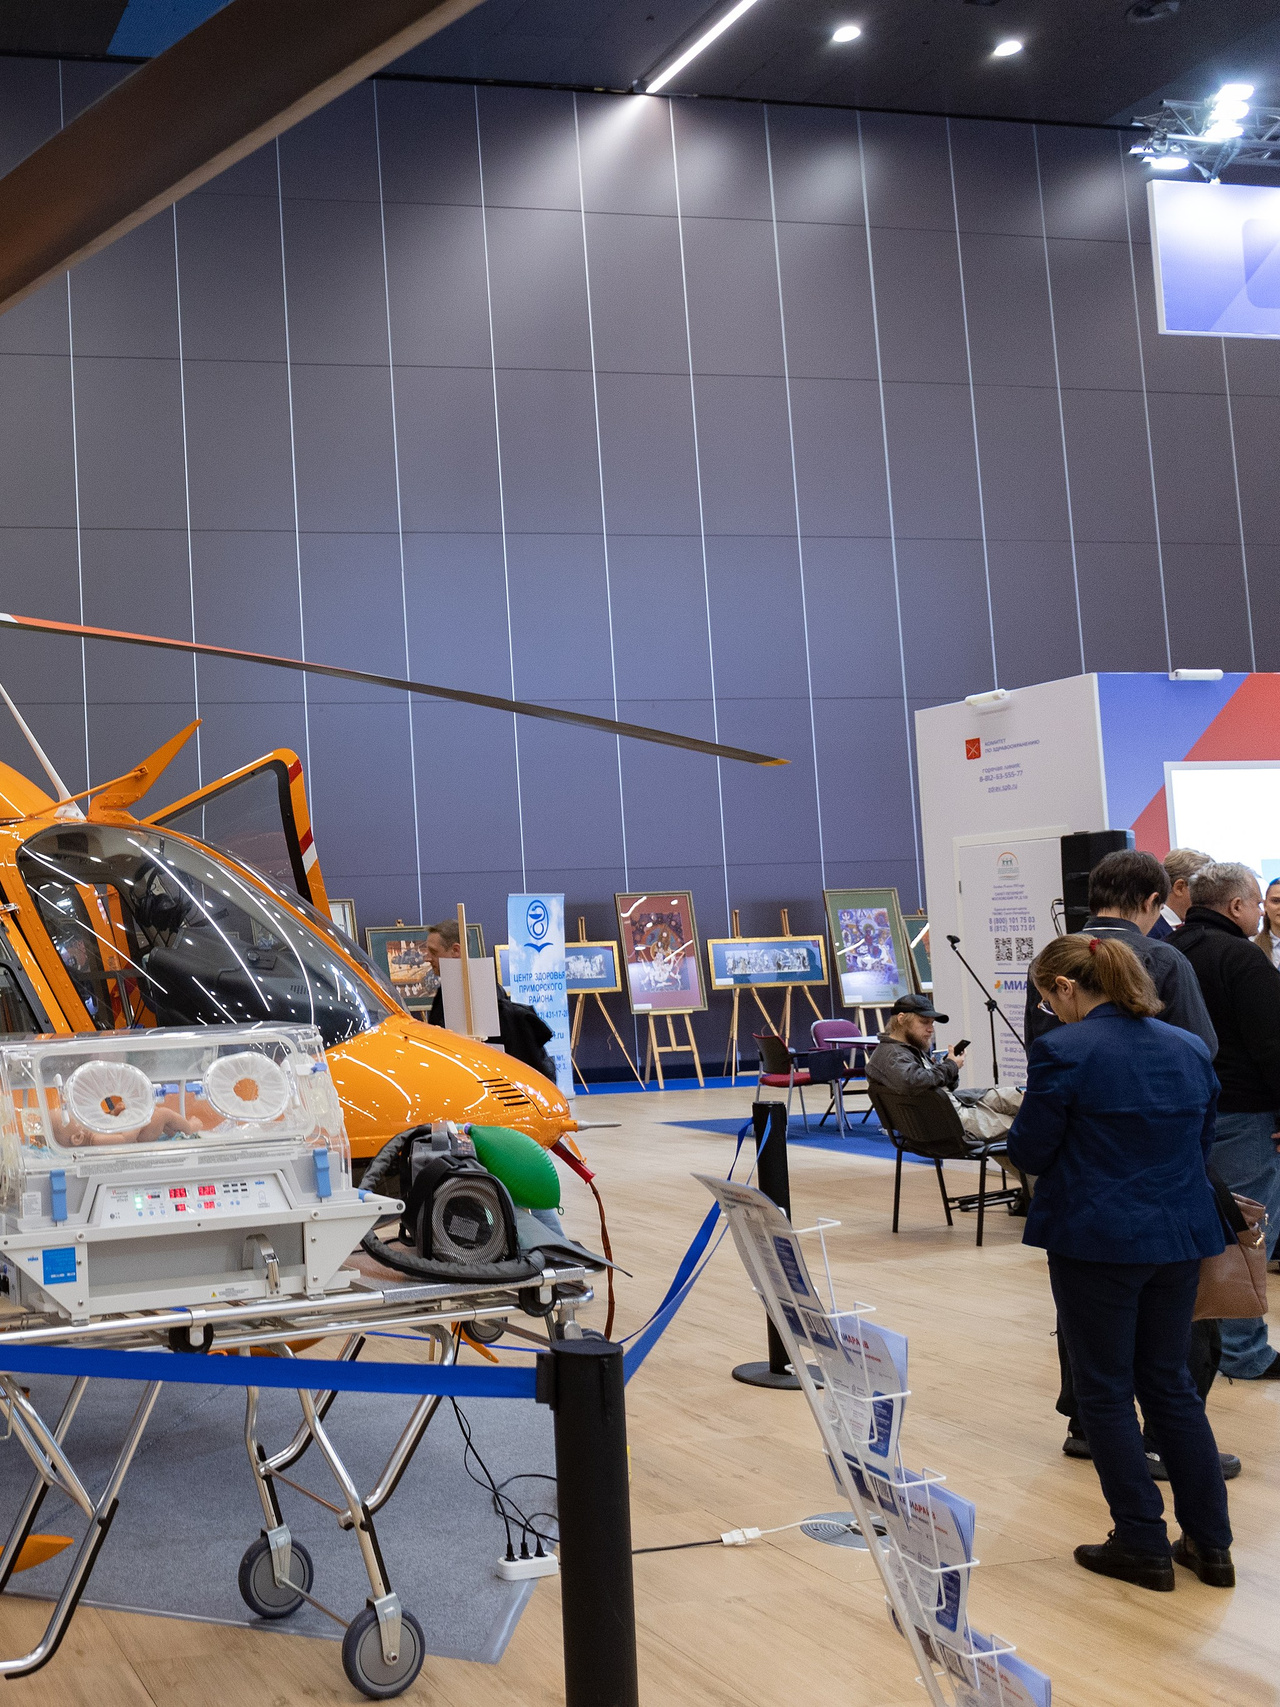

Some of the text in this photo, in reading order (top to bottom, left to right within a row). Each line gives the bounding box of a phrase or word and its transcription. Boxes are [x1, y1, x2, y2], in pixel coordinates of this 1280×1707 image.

[513, 971, 565, 982] ЦЕНТР ЗДОРОВЬЯ
[519, 983, 562, 993] ПРИМОРСКОГО
[529, 994, 553, 1003] РАЙОНА
